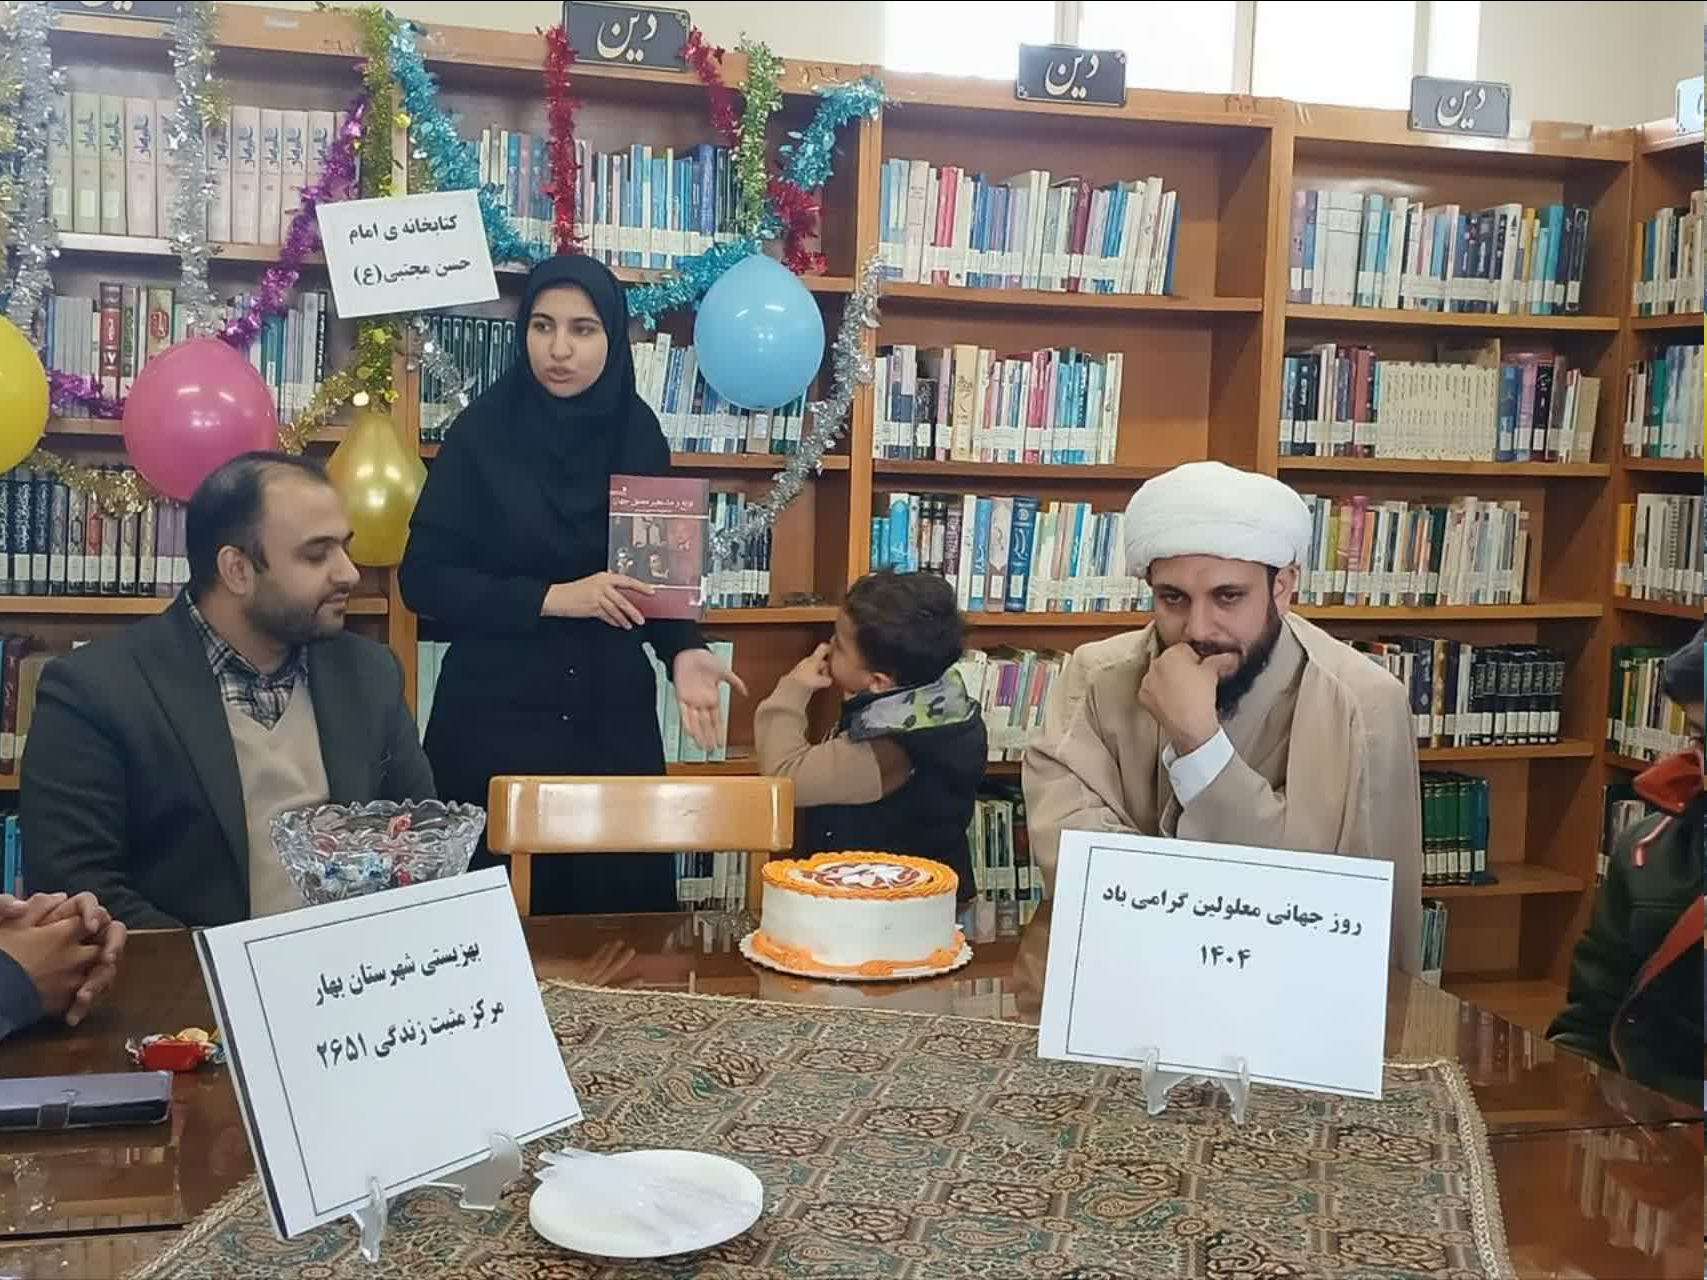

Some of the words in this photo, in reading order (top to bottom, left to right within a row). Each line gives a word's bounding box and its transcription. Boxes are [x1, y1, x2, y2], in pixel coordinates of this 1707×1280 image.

[596, 13, 658, 62] دین
[1044, 53, 1100, 99] دین
[1436, 87, 1486, 129] دین
[349, 223, 379, 245] امام
[383, 226, 398, 241] ی
[402, 214, 457, 237] کتابخانه
[435, 257, 471, 277] حسن
[1102, 884, 1127, 906] باد
[1131, 889, 1189, 913] گرامی
[1192, 895, 1261, 920] معلولین
[1266, 902, 1323, 930] جهانی
[1328, 912, 1362, 936] روز
[420, 942, 482, 977] بهزیستی
[1200, 944, 1252, 969] ۱۴۰۴
[349, 953, 416, 995] شهرستان
[316, 973, 345, 1006] بهار
[428, 1008, 466, 1035] مثبت
[471, 998, 505, 1029] مرکز
[316, 1032, 368, 1069] ۲۶۵۱
[374, 1018, 428, 1058] زندگی
